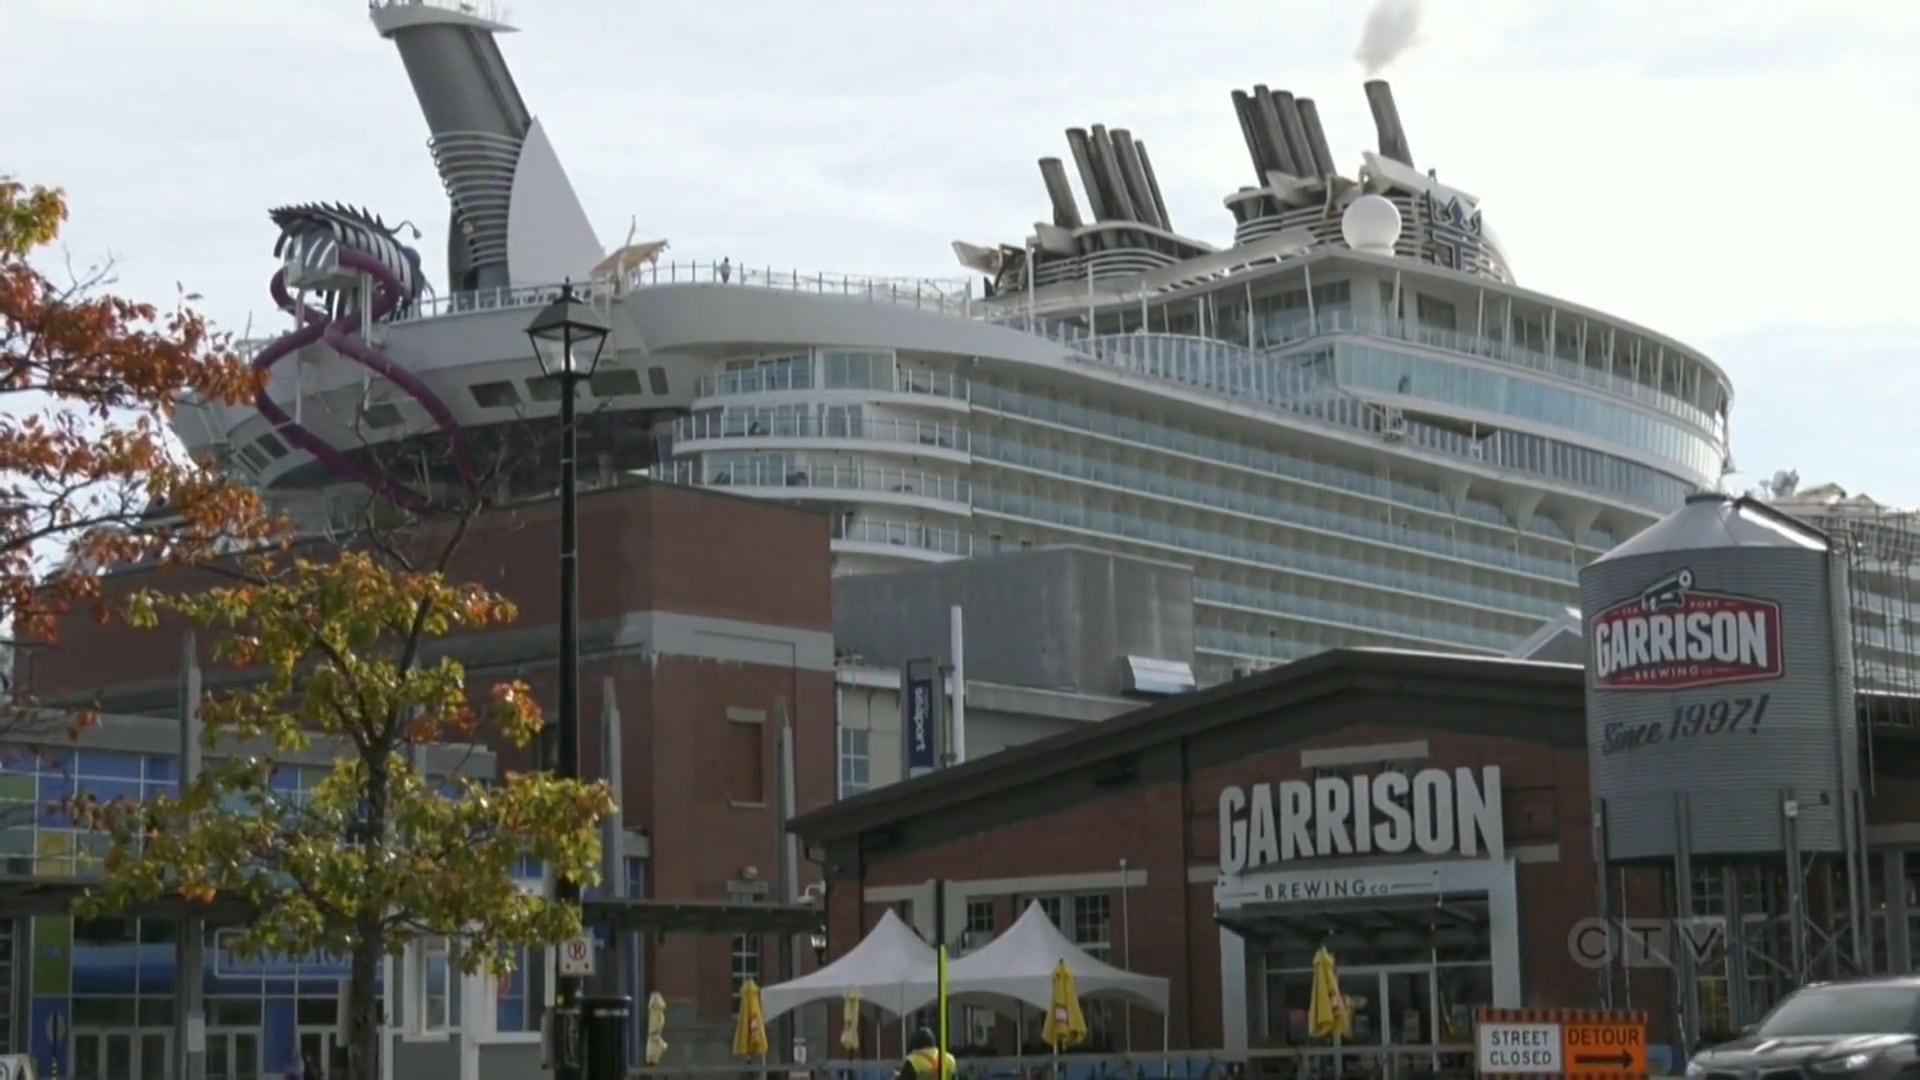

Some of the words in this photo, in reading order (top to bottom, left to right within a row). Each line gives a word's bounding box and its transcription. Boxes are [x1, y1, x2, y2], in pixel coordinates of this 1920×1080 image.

[1597, 611, 1767, 677] GARRISON
[1634, 665, 1699, 682] BREWING
[1603, 720, 1662, 753] Since
[1668, 694, 1771, 742] 1997!
[1219, 765, 1504, 875] GARRISON
[1265, 879, 1366, 900] BREWING
[1491, 1030, 1549, 1046] STREET
[1568, 1028, 1639, 1046] DETOUR
[1490, 1051, 1552, 1066] CLOSED
